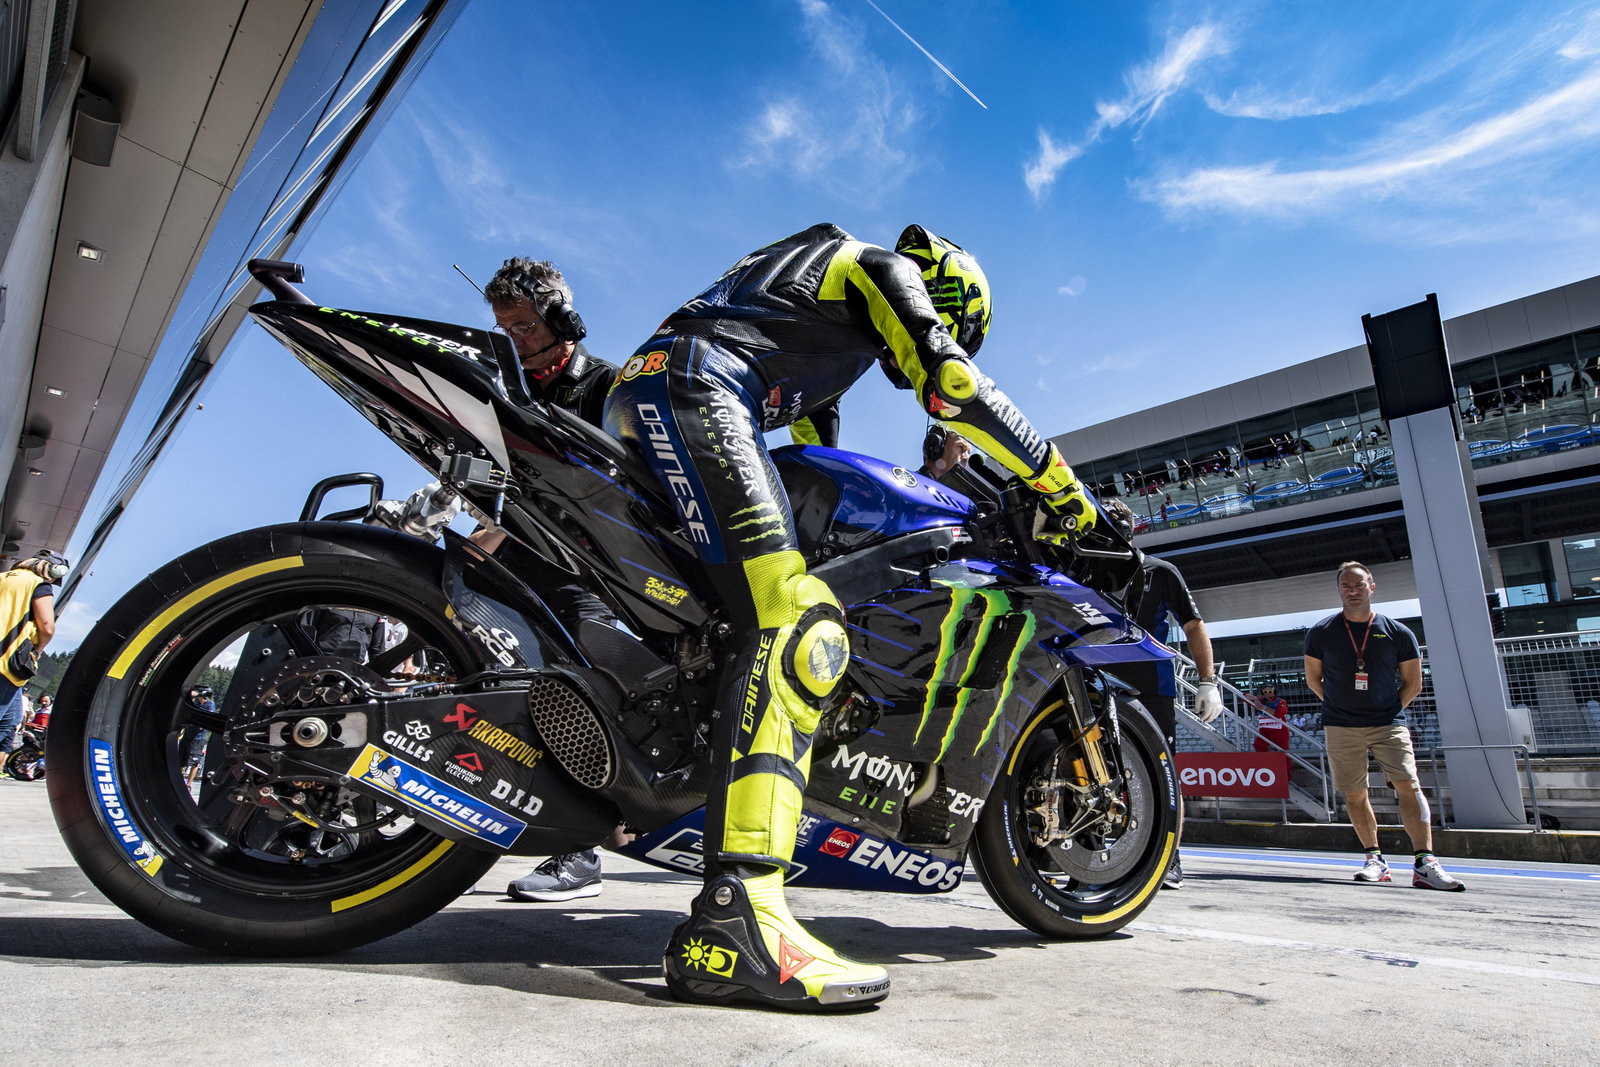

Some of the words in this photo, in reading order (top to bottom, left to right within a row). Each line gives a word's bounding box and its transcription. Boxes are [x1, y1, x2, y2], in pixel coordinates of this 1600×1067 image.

[319, 306, 452, 353] ENERGY
[699, 406, 735, 482] ENERGY
[710, 390, 760, 496] MONSTER
[984, 387, 1048, 464] YAMAHA
[637, 403, 711, 545] DAINESE
[472, 625, 515, 667] RCB
[741, 634, 772, 734] DAINESE
[382, 730, 434, 762] GILLES
[444, 760, 482, 783] FURUKAWA
[94, 748, 140, 843] MICHELIN
[445, 768, 475, 785] ELECTRIC
[1179, 767, 1276, 787] enovo
[401, 779, 508, 835] MICHELIN
[827, 837, 851, 849] ENEOS
[848, 838, 963, 890] ENEOS
